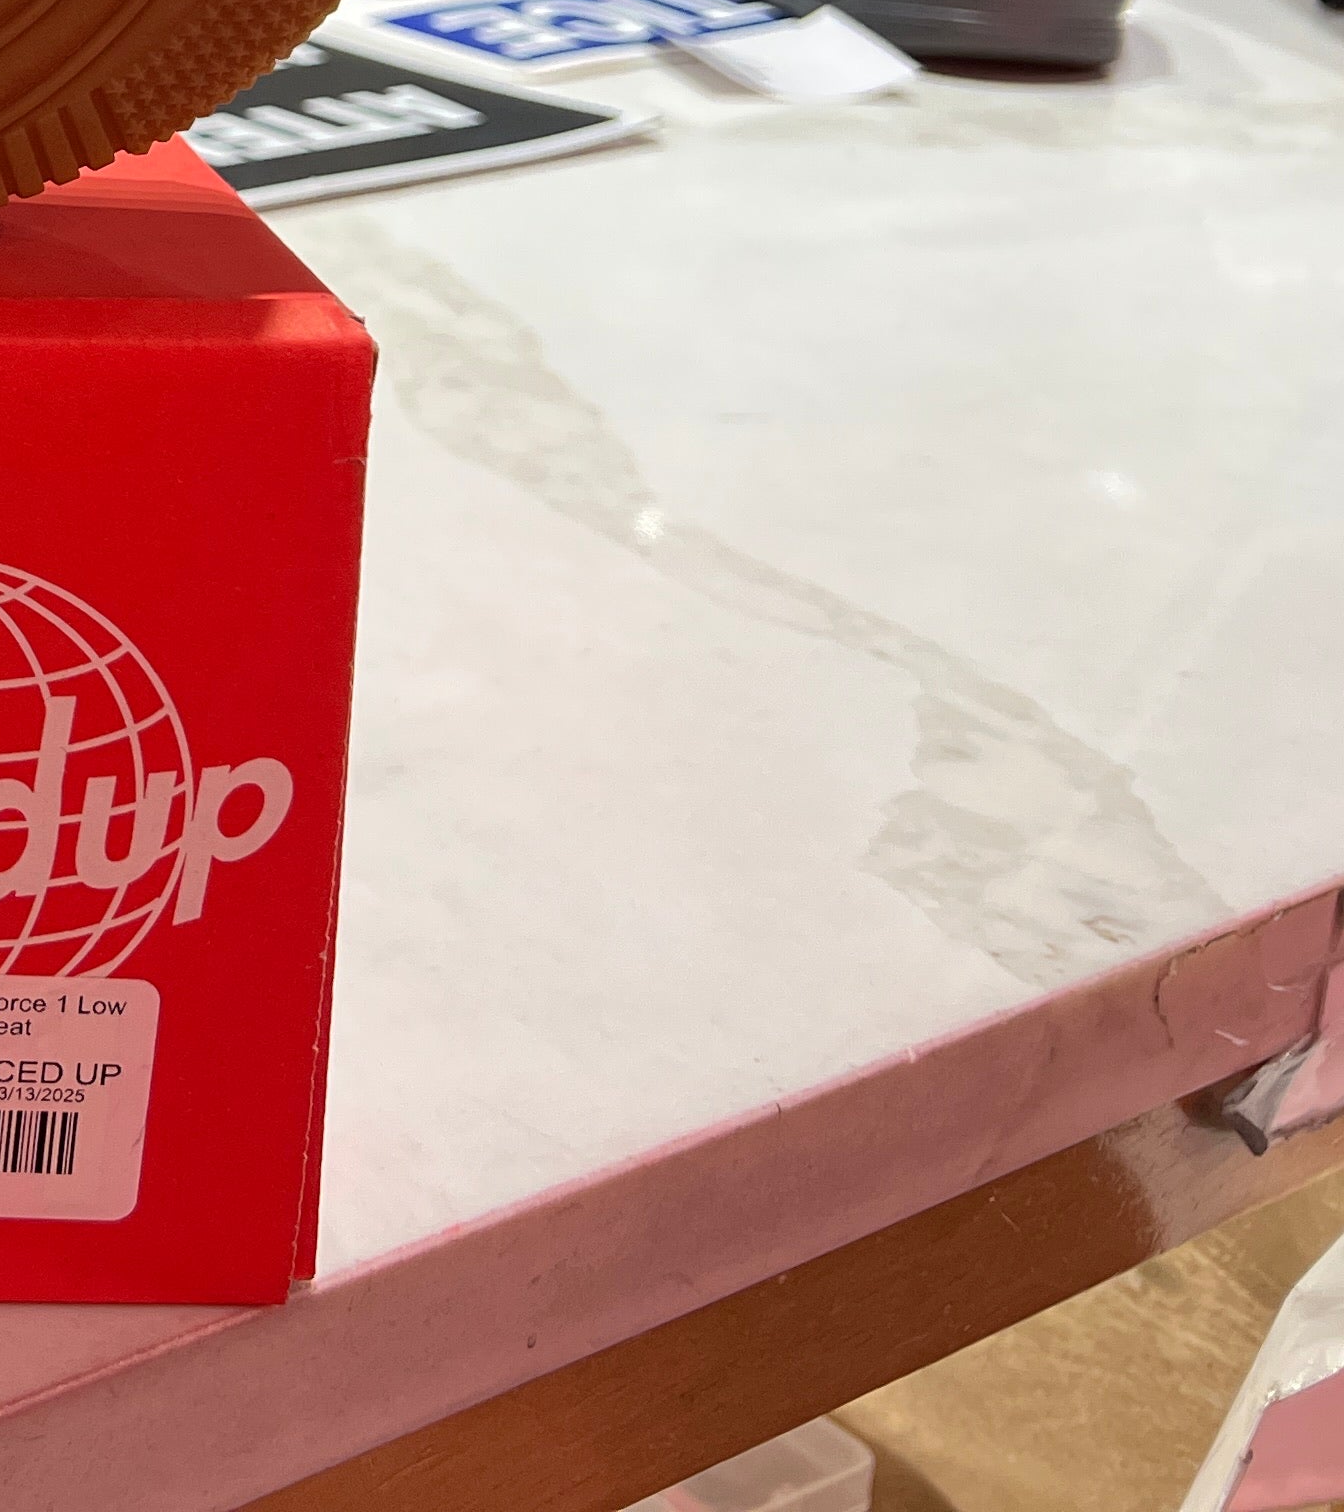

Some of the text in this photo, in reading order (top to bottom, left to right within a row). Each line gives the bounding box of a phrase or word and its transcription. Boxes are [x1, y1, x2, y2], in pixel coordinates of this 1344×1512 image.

[57, 995, 67, 1013] 1
[78, 995, 128, 1016] Low
[75, 1062, 123, 1086] UP
